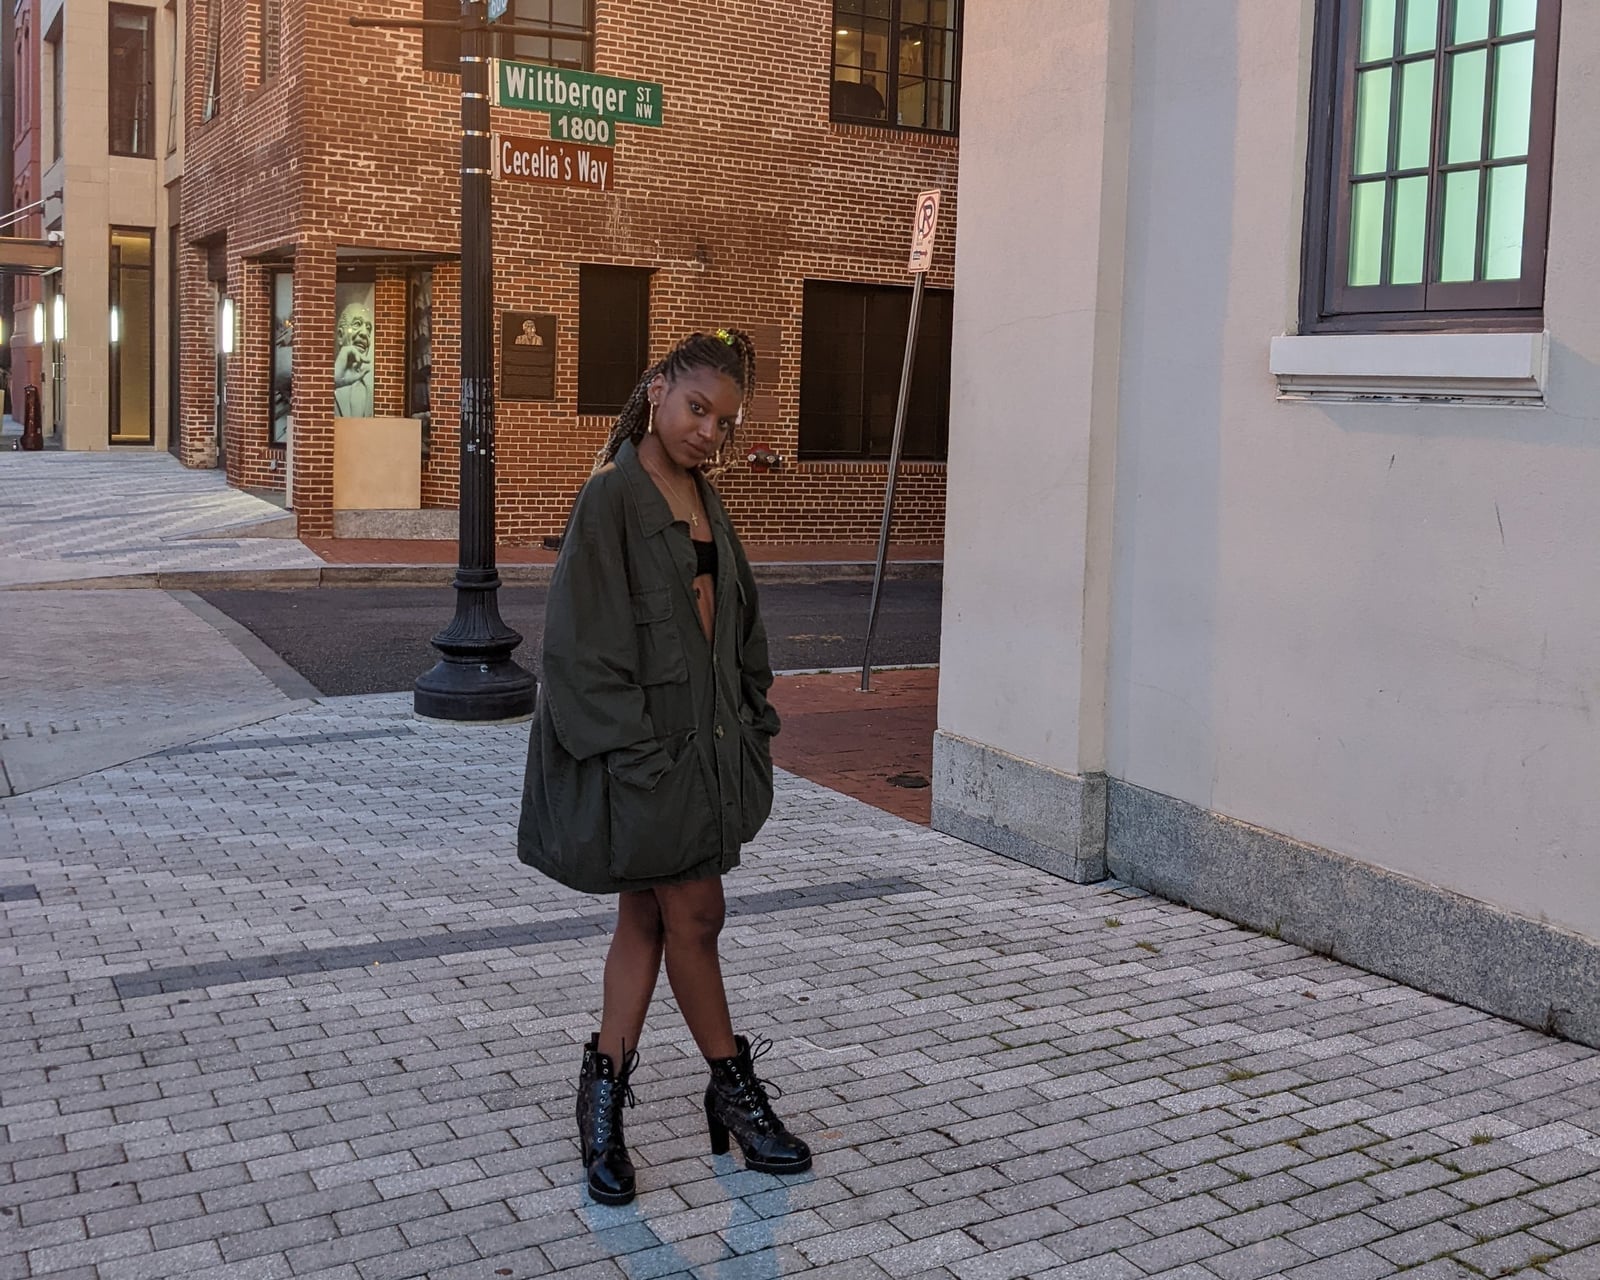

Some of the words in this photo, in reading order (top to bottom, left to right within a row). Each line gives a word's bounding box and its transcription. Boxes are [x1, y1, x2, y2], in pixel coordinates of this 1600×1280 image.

[505, 66, 627, 115] Wiltberger
[636, 87, 652, 102] ST
[635, 104, 653, 119] NW
[558, 115, 609, 143] 1800
[502, 141, 572, 181] Cecelia's
[577, 150, 607, 191] Way
